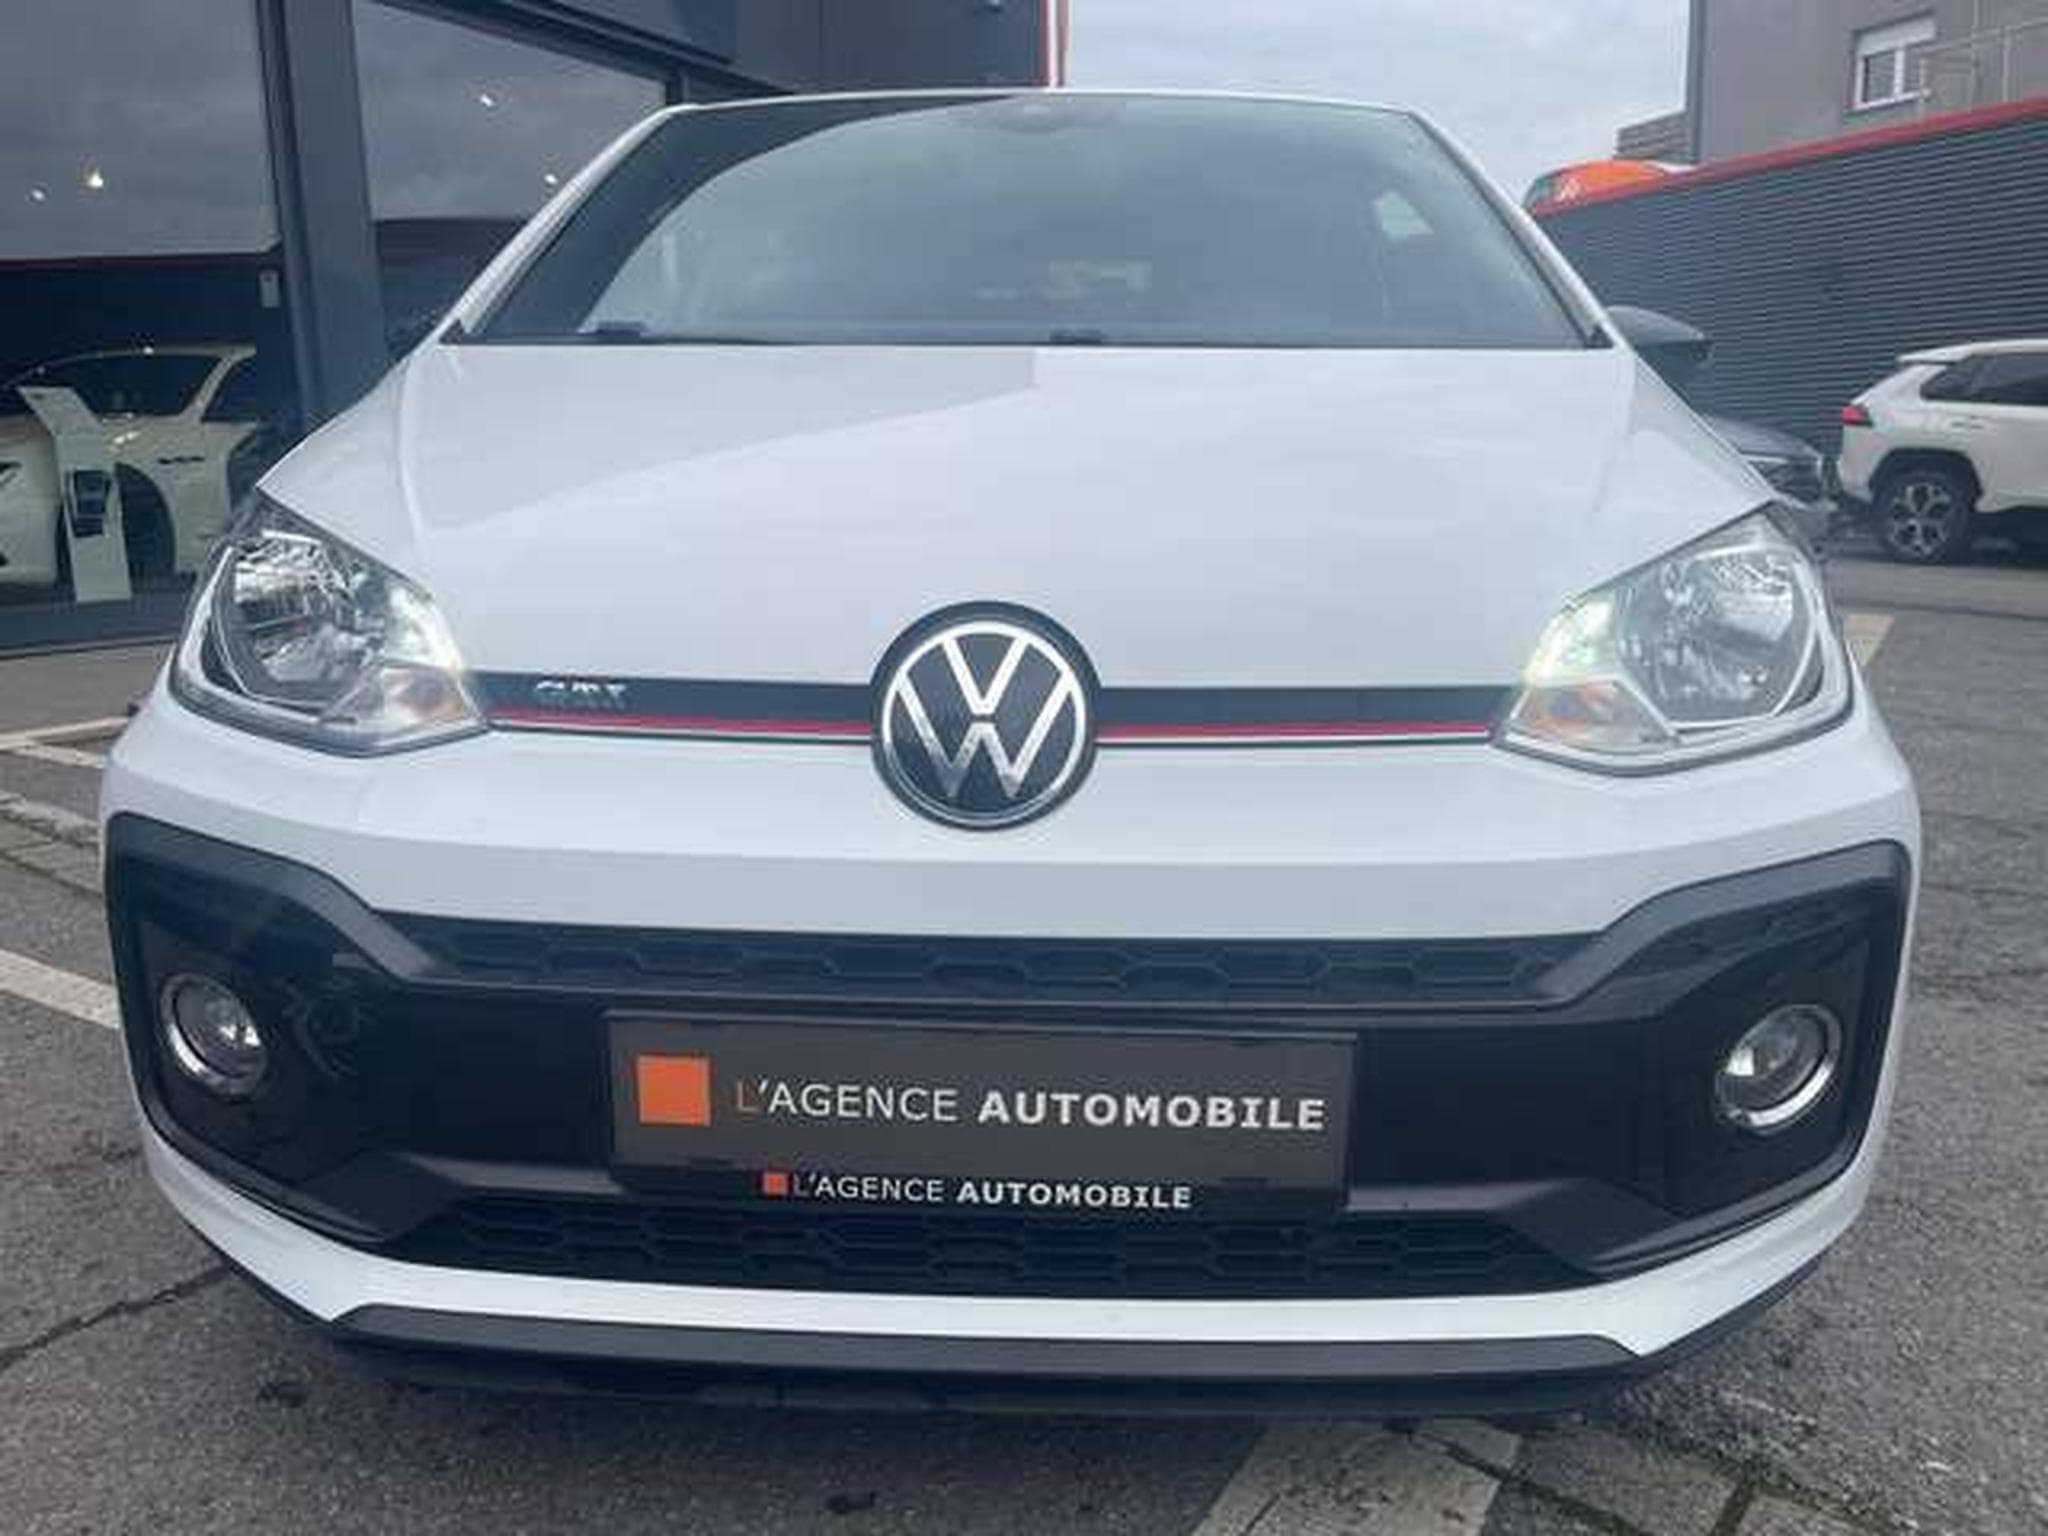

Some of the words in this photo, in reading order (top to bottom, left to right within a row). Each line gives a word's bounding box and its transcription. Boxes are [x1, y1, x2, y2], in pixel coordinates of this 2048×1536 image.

[735, 1079, 958, 1122] L'AGENCE
[977, 1089, 1325, 1131] AUTOMOBILE
[793, 1171, 944, 1201] L'AGENCE
[955, 1180, 1193, 1209] AUTOMOBILE
